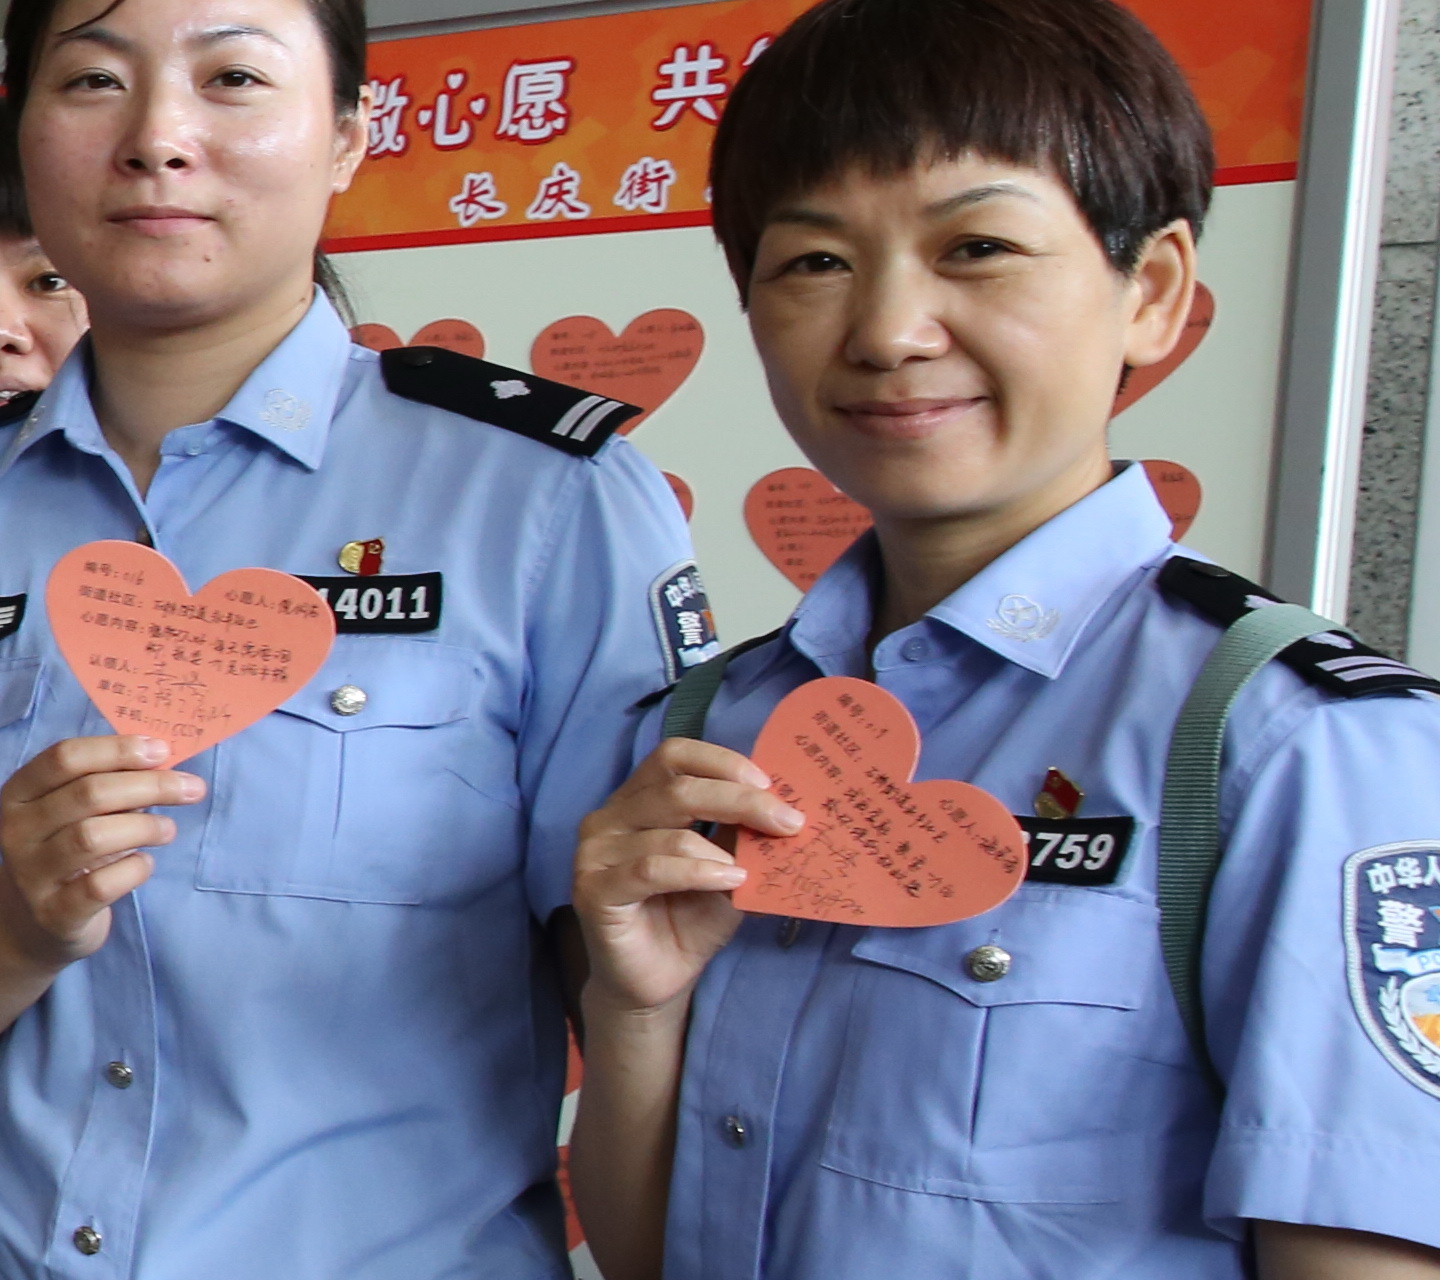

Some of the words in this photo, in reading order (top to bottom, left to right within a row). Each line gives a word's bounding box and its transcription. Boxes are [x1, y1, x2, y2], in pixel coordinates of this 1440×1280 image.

[449, 157, 714, 227] 长庆街
[1020, 832, 1115, 871] 759
[1377, 899, 1425, 948] 警
